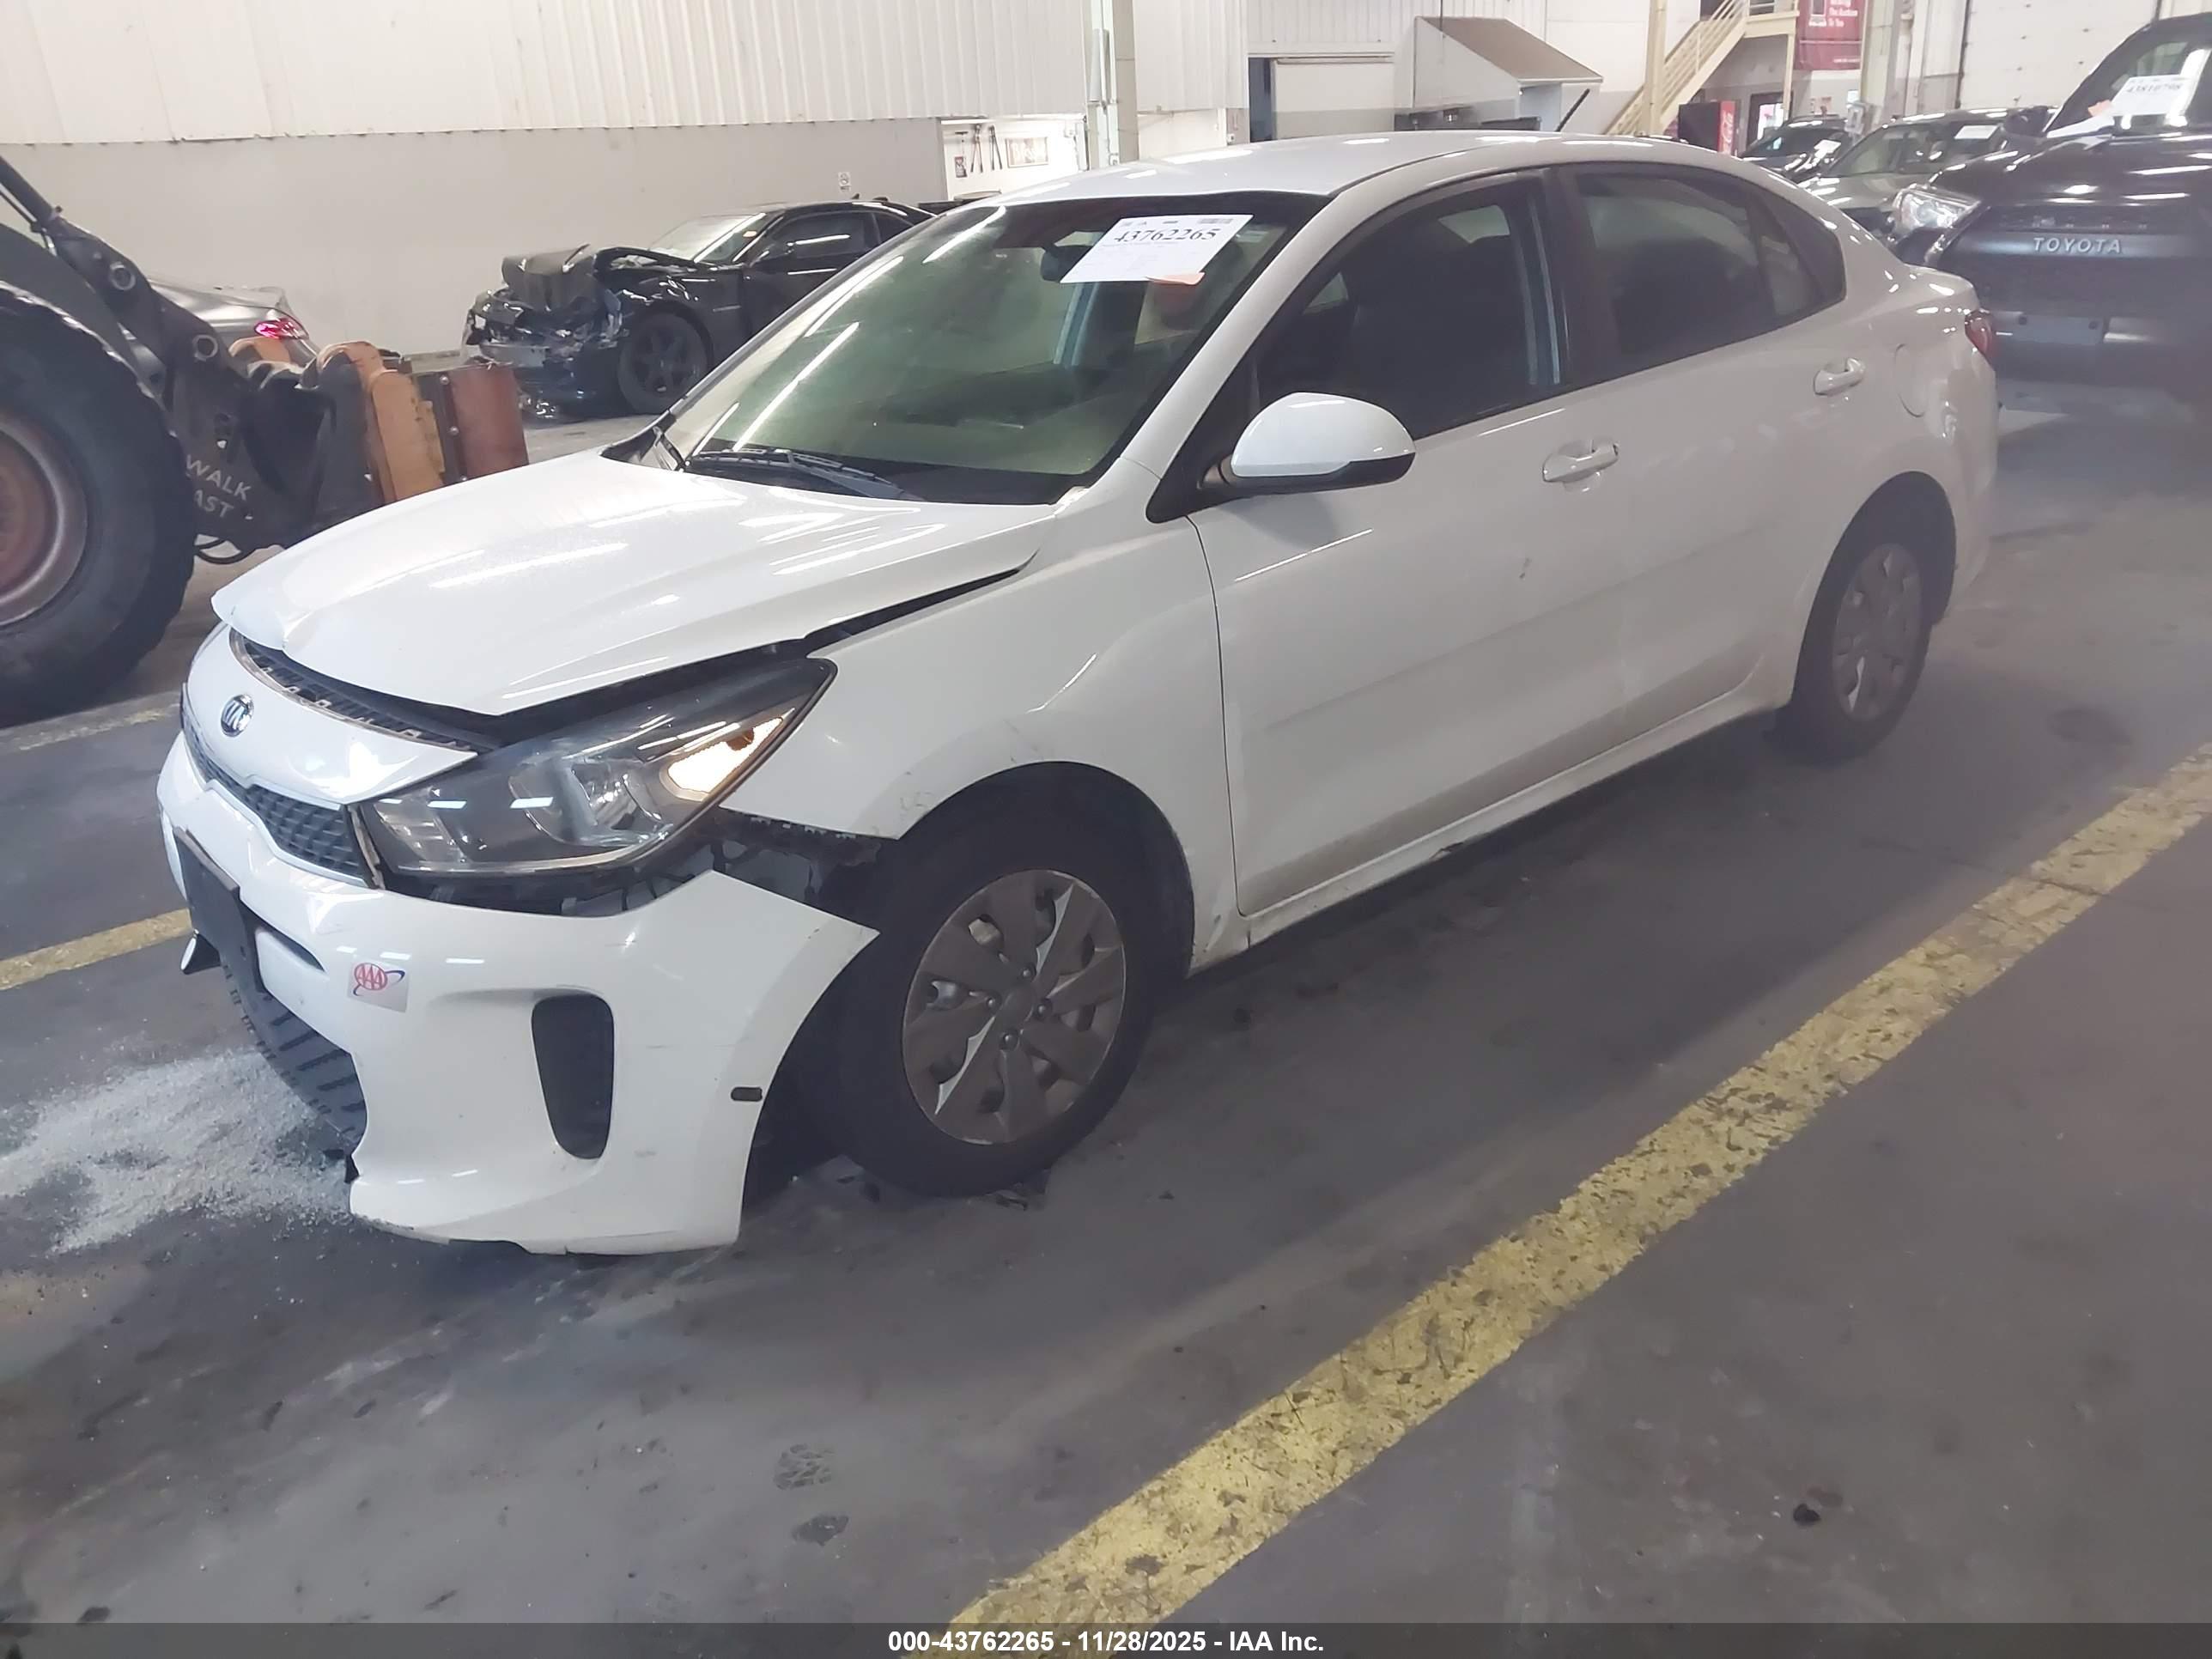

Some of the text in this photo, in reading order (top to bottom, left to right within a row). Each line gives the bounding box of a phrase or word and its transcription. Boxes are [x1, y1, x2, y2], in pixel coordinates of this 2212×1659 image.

[1114, 228, 1221, 242] 43762265
[2033, 237, 2121, 253] TOYOTA
[186, 453, 252, 501] WALK
[357, 963, 384, 989] AAA
